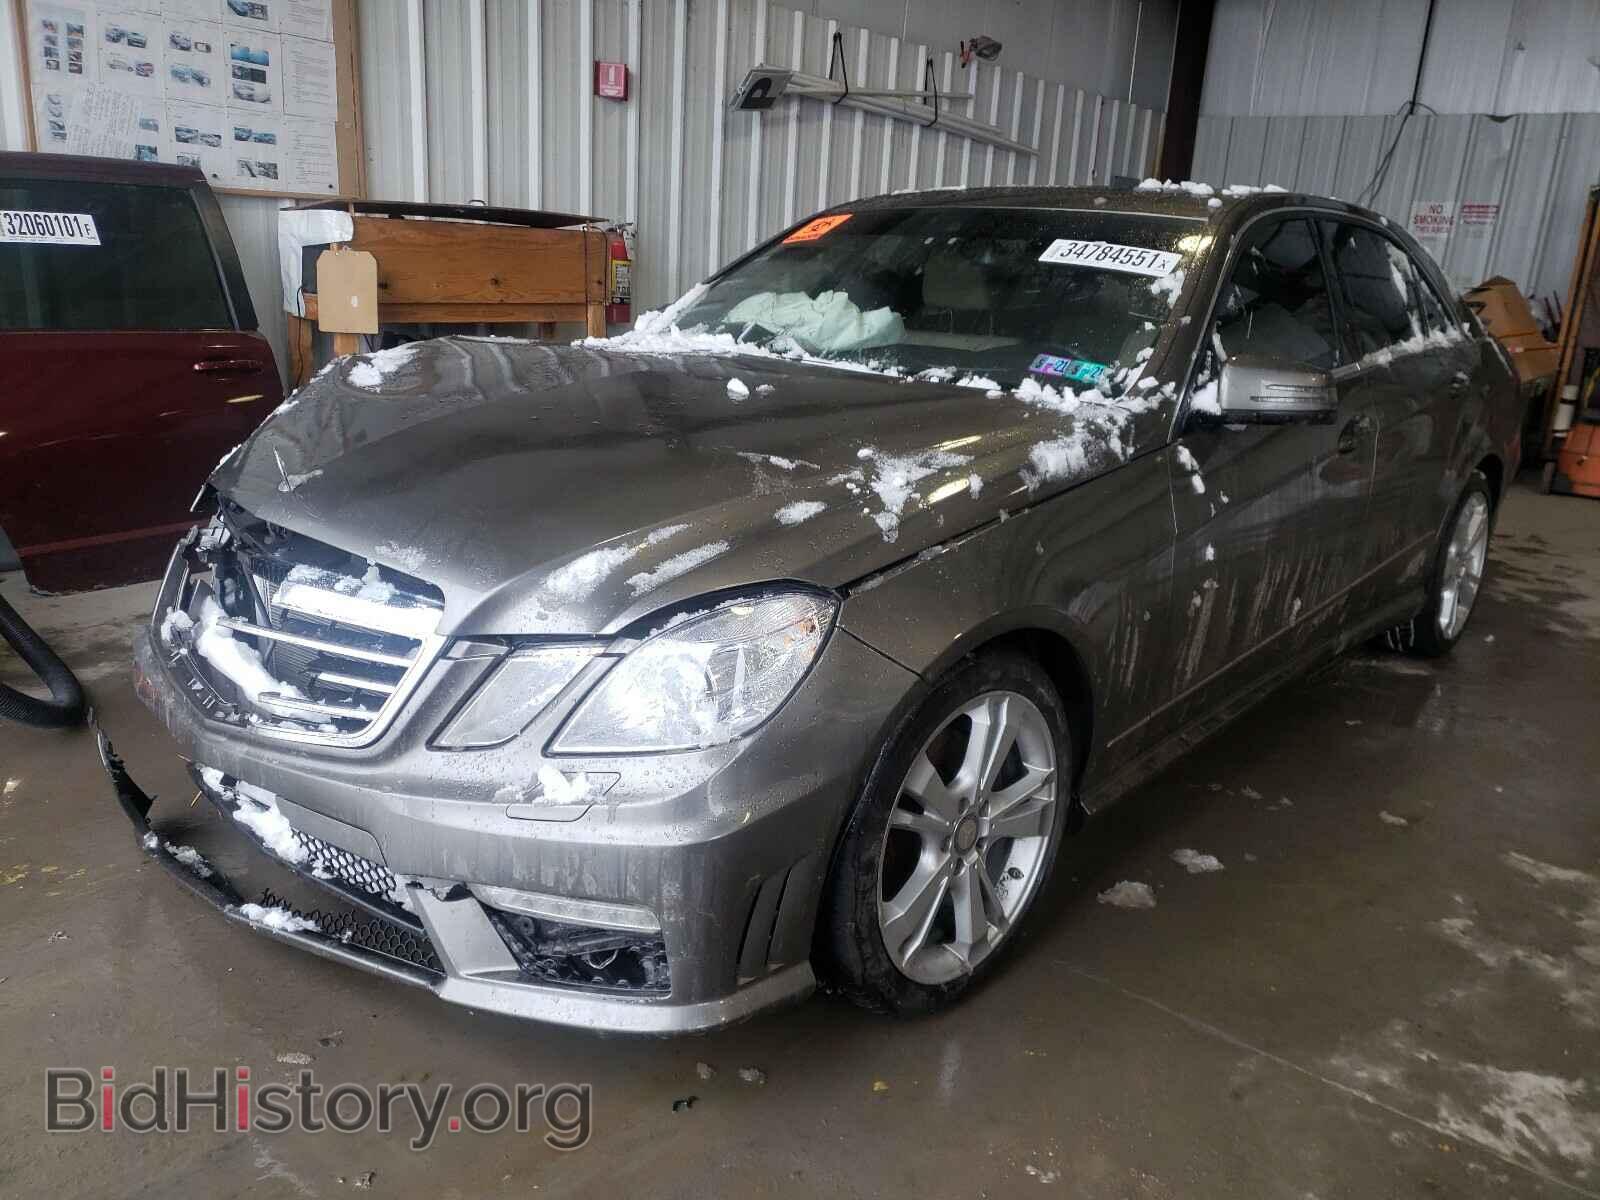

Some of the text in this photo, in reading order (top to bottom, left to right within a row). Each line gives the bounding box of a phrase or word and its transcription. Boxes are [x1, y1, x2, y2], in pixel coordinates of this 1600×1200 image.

[1430, 204, 1444, 214] NO
[3, 212, 83, 237] 32060101
[84, 223, 91, 236] F
[1060, 242, 1160, 268] 34784551
